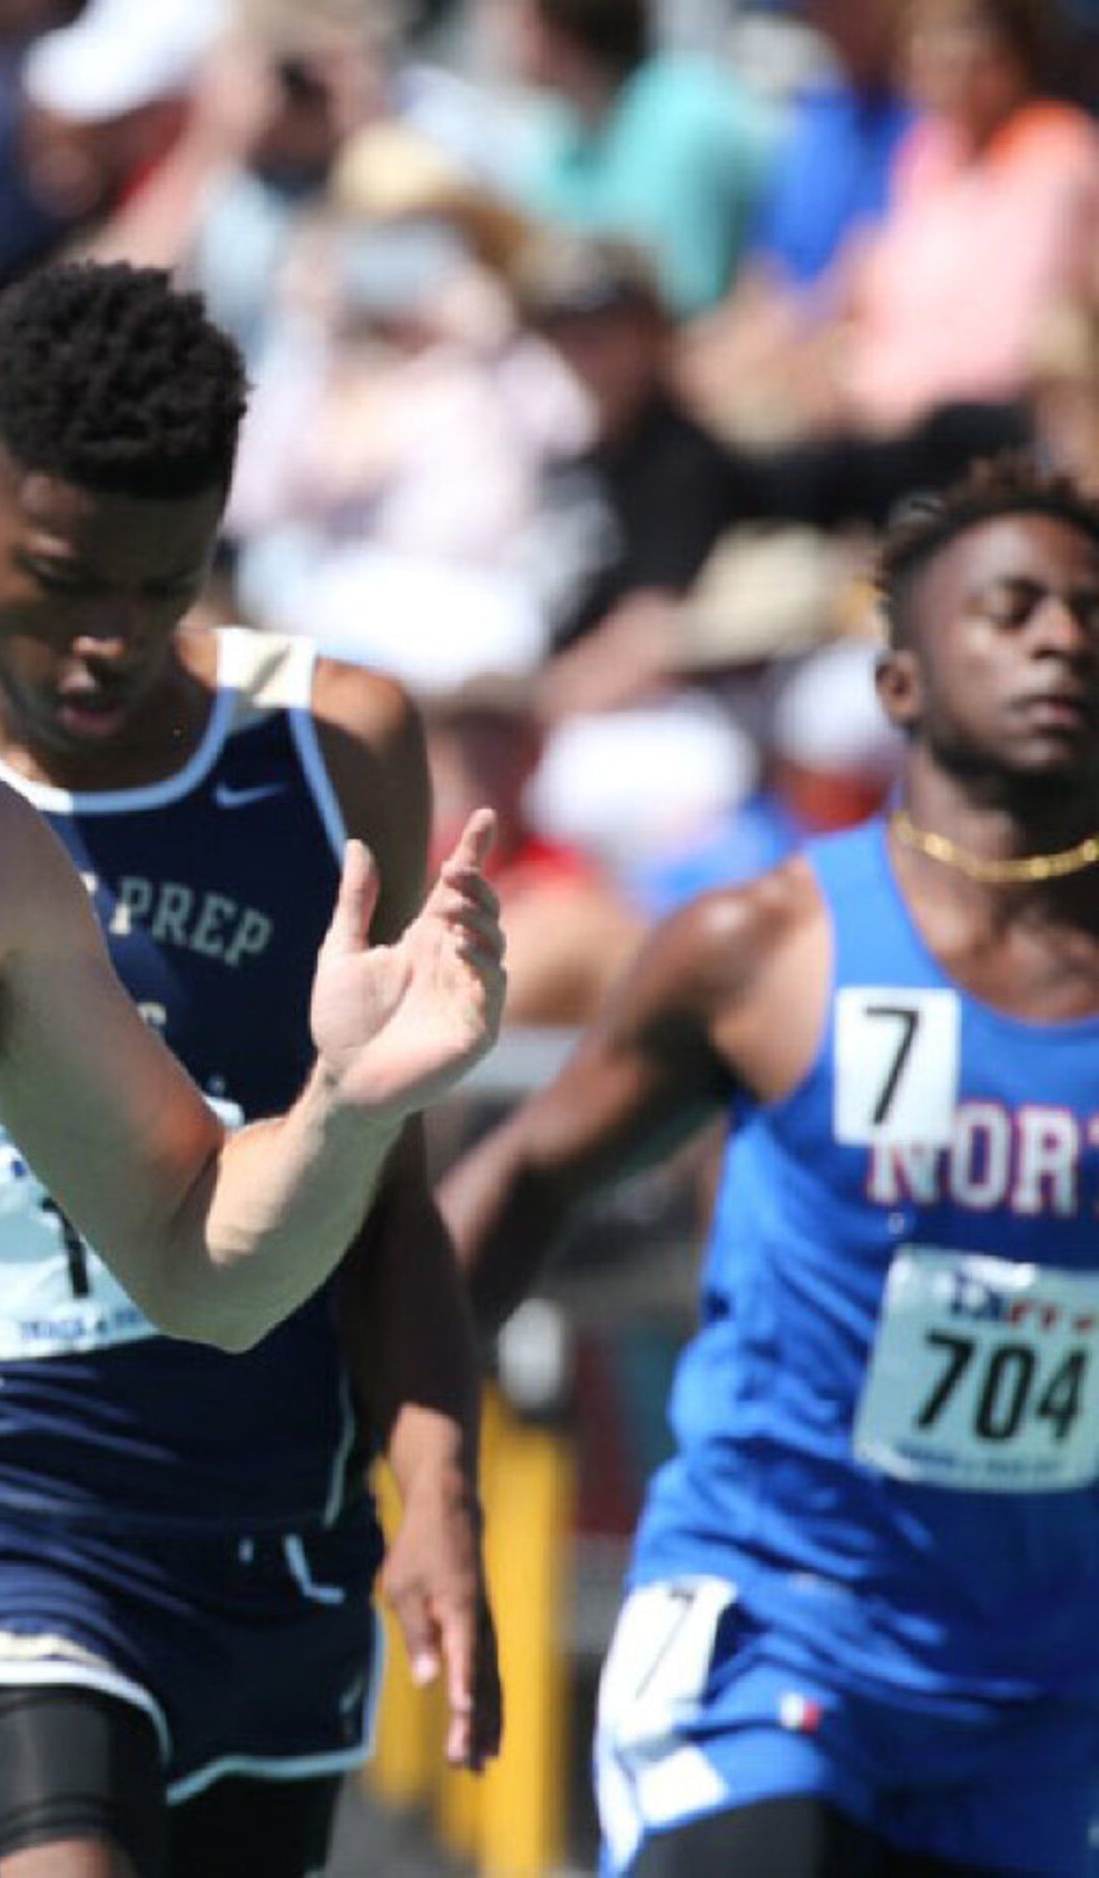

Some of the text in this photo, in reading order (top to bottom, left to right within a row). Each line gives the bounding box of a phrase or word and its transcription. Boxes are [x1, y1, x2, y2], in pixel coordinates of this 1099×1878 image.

[109, 877, 273, 967] PREP
[865, 1006, 919, 1126] 7
[868, 1102, 1099, 1214] NOR
[917, 1327, 1089, 1442] 704
